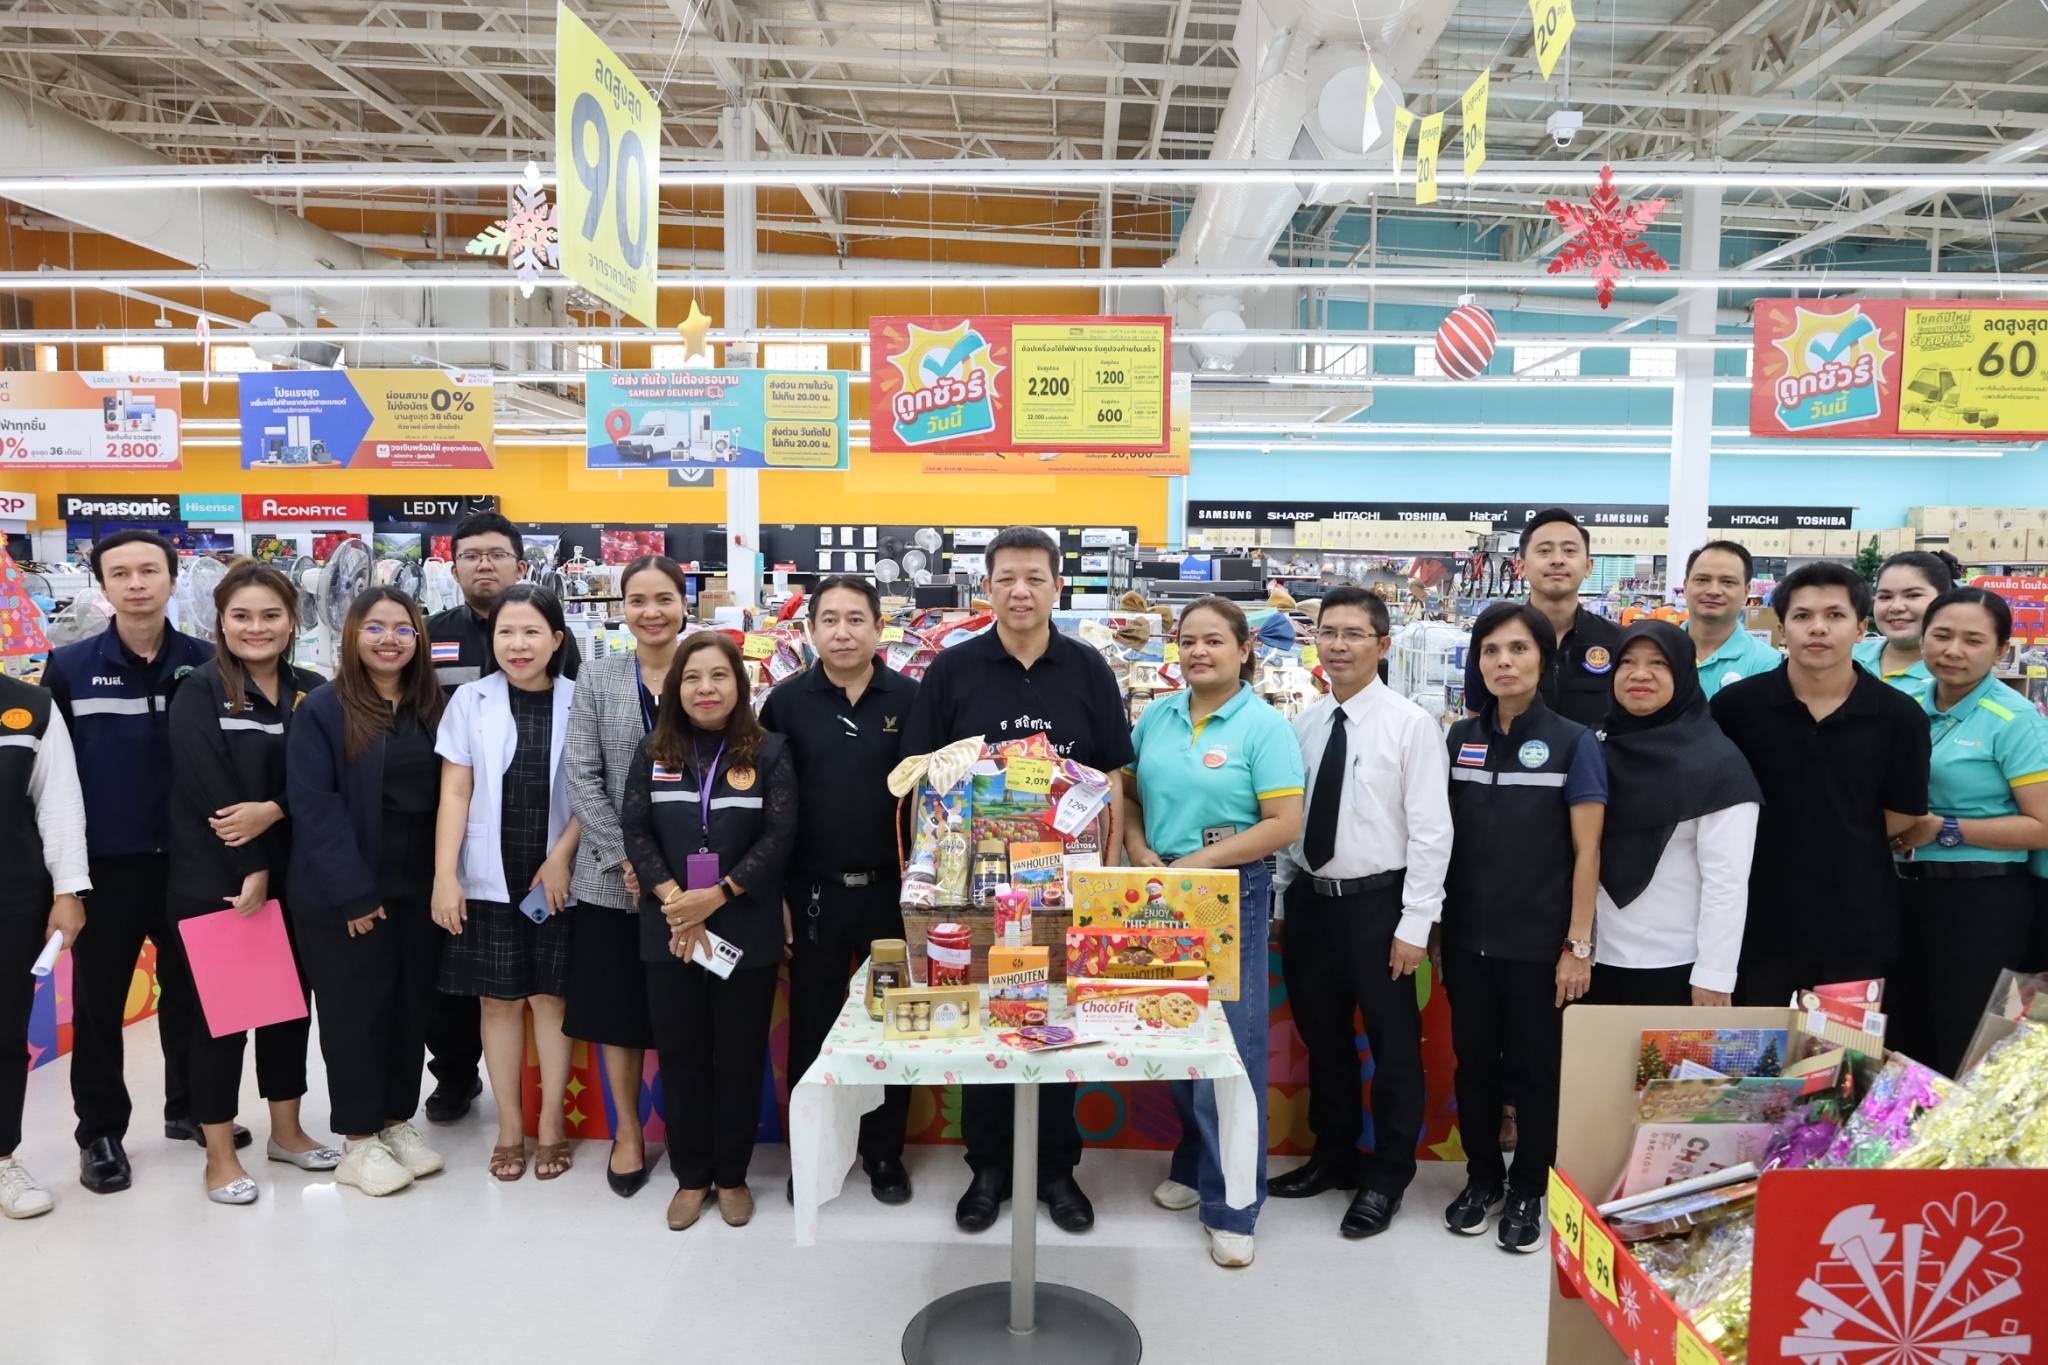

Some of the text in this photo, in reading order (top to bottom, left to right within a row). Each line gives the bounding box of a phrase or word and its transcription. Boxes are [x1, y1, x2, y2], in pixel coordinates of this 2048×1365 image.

[595, 57, 642, 124] ลดสูงสุด
[1983, 318, 2048, 336] ลดสูงสุด
[611, 374, 638, 386] จัดส่ง
[671, 372, 739, 385] ไม่ต้องรอนาน
[769, 380, 796, 389] ส่งด่วน
[1095, 370, 1125, 386] 1,200
[1780, 356, 1872, 404] ถูกชัวร์
[274, 386, 320, 399] โปรแรงสุด
[628, 389, 705, 398] SAMEDAY DELIVERY
[1028, 377, 1070, 397] 2,200
[385, 390, 429, 400] ผ่อนสบาย
[431, 389, 475, 412] 0%
[772, 391, 795, 401] ไม่เกิน
[897, 369, 986, 421] ถูกชัวร์
[1810, 389, 1848, 420] วันนี้
[430, 412, 442, 421] 36
[443, 411, 464, 421] เดือน
[926, 404, 963, 434] วันนี้
[1097, 408, 1123, 423] 600
[771, 427, 798, 436] ส่งด่วน
[772, 438, 795, 447] ไม่เกิน
[797, 440, 820, 448] 20.00
[50, 446, 63, 456] 36
[67, 498, 171, 516] Panasonic
[186, 502, 235, 512] Hisense
[1198, 510, 1252, 520] SAMSUNG
[1267, 511, 1314, 521] SHARP
[1333, 511, 1380, 521] HITACHI
[1398, 512, 1447, 521] TOSHIBA
[1469, 510, 1508, 522] Hatari
[1594, 514, 1649, 524] SAMSUNG
[1730, 515, 1779, 526] HITACHI
[1796, 516, 1846, 526] TOSHIBA
[92, 675, 124, 686] คบส.
[1014, 714, 1052, 730] สถิตใน
[1025, 776, 1050, 786] 2,079
[1065, 842, 1097, 850] GUSTOSA
[1144, 908, 1170, 919] ENJOY
[1565, 1212, 1579, 1243] 99
[1596, 1257, 1610, 1288] 99
